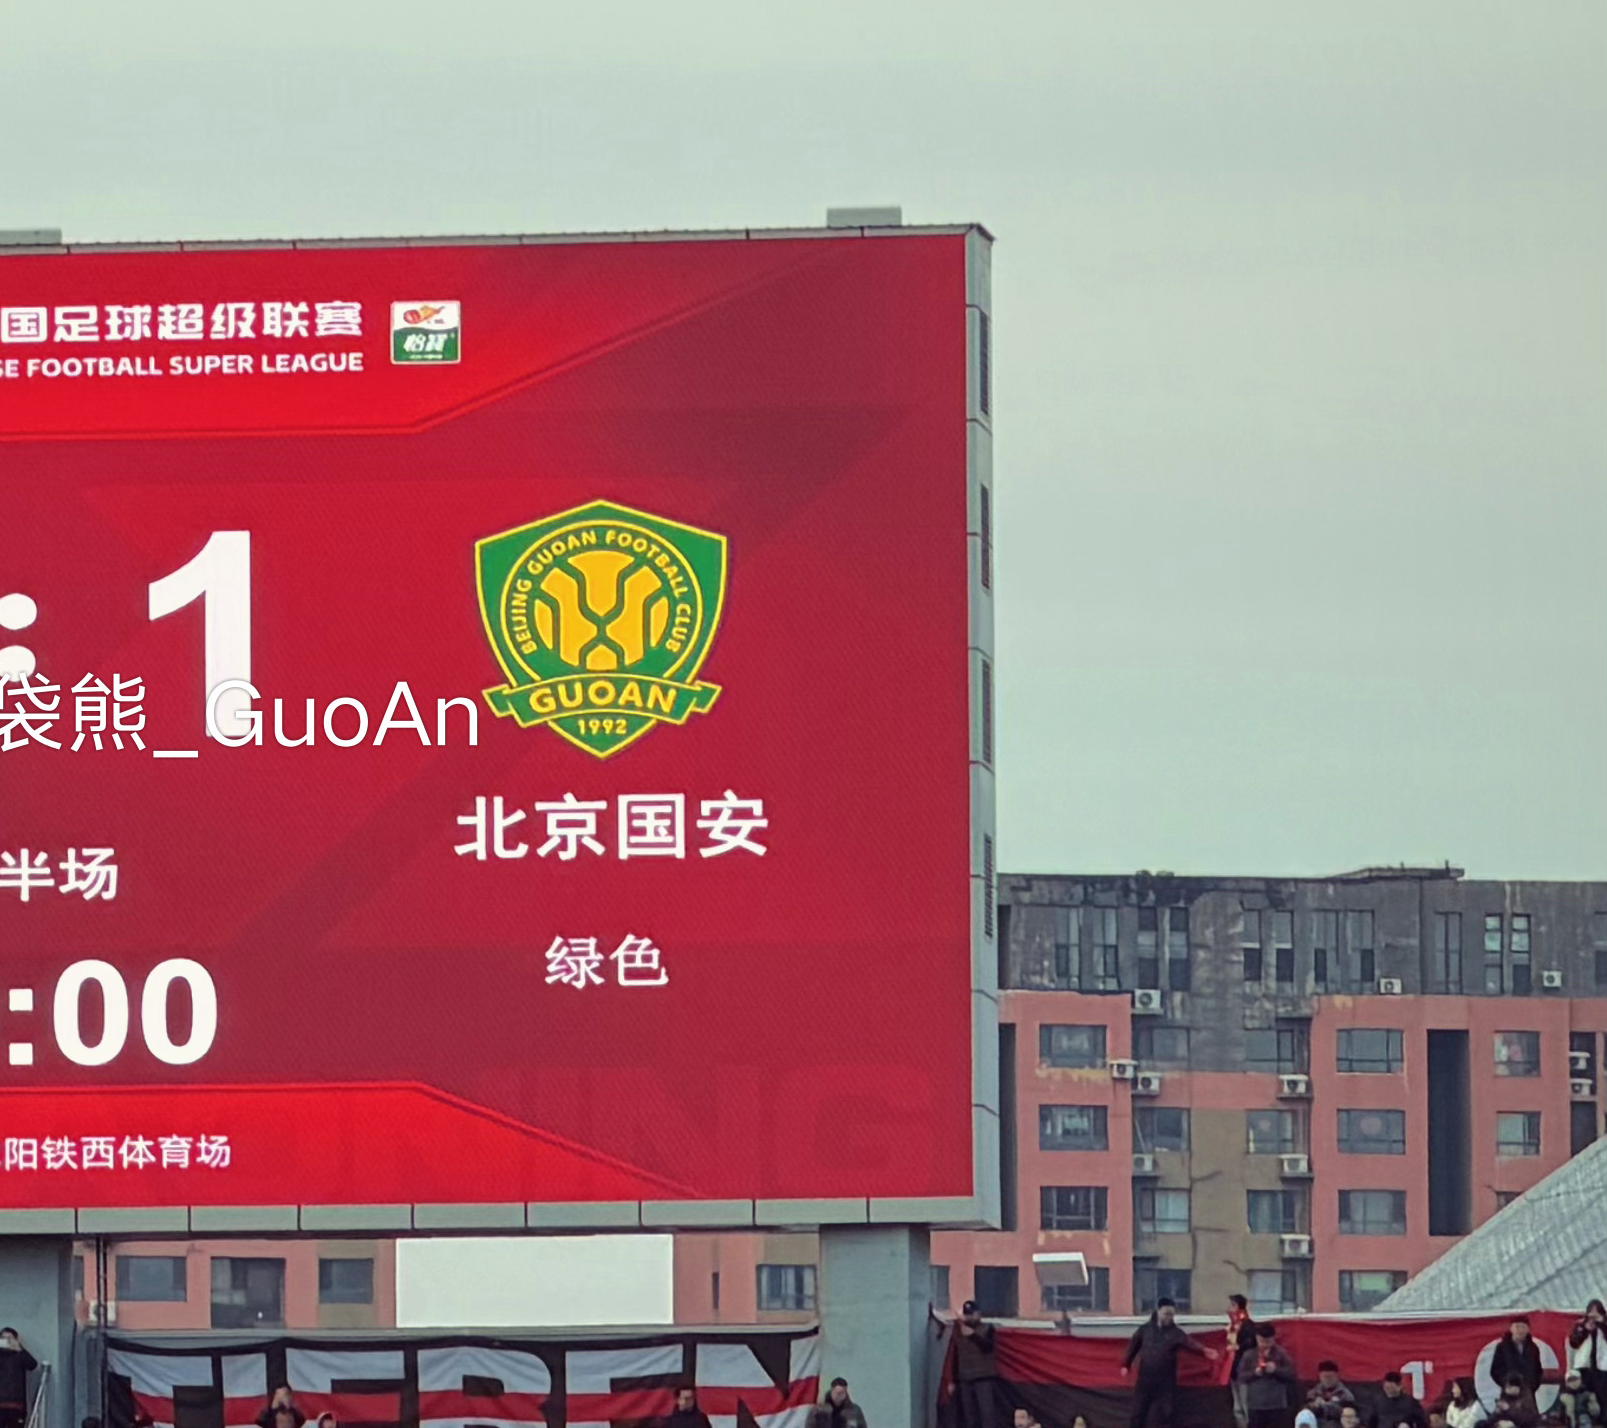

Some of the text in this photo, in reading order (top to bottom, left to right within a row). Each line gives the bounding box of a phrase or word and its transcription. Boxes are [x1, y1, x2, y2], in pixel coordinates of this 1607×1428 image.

[27, 356, 163, 378] FOOTBALL
[169, 354, 253, 375] SUPER
[261, 352, 364, 373] LEAGUE
[511, 529, 692, 655] BEIJING GUOAN FOOTBALL CLUB
[529, 680, 677, 714] GUOAN
[578, 719, 627, 735] 1992
[454, 790, 769, 860] 北京国安
[544, 933, 669, 989] 绿色
